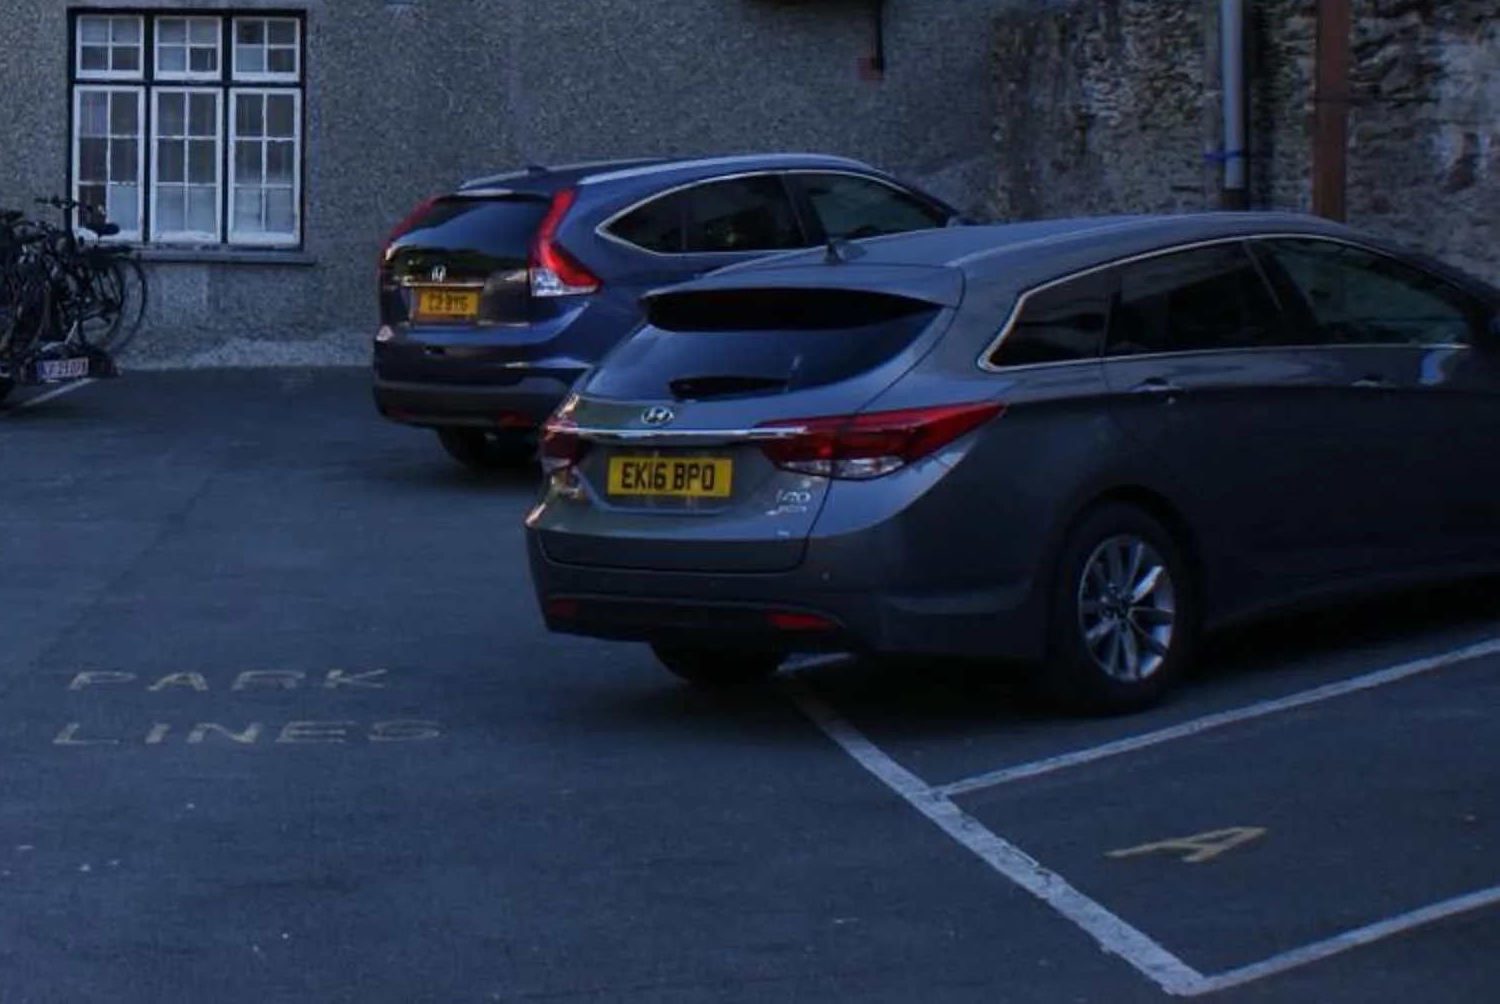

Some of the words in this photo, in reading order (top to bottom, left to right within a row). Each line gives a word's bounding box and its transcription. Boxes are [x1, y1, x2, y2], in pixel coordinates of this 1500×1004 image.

[620, 461, 668, 490] EK16
[672, 462, 716, 491] BPO
[69, 668, 388, 691] PARK
[52, 719, 441, 746] LINES
